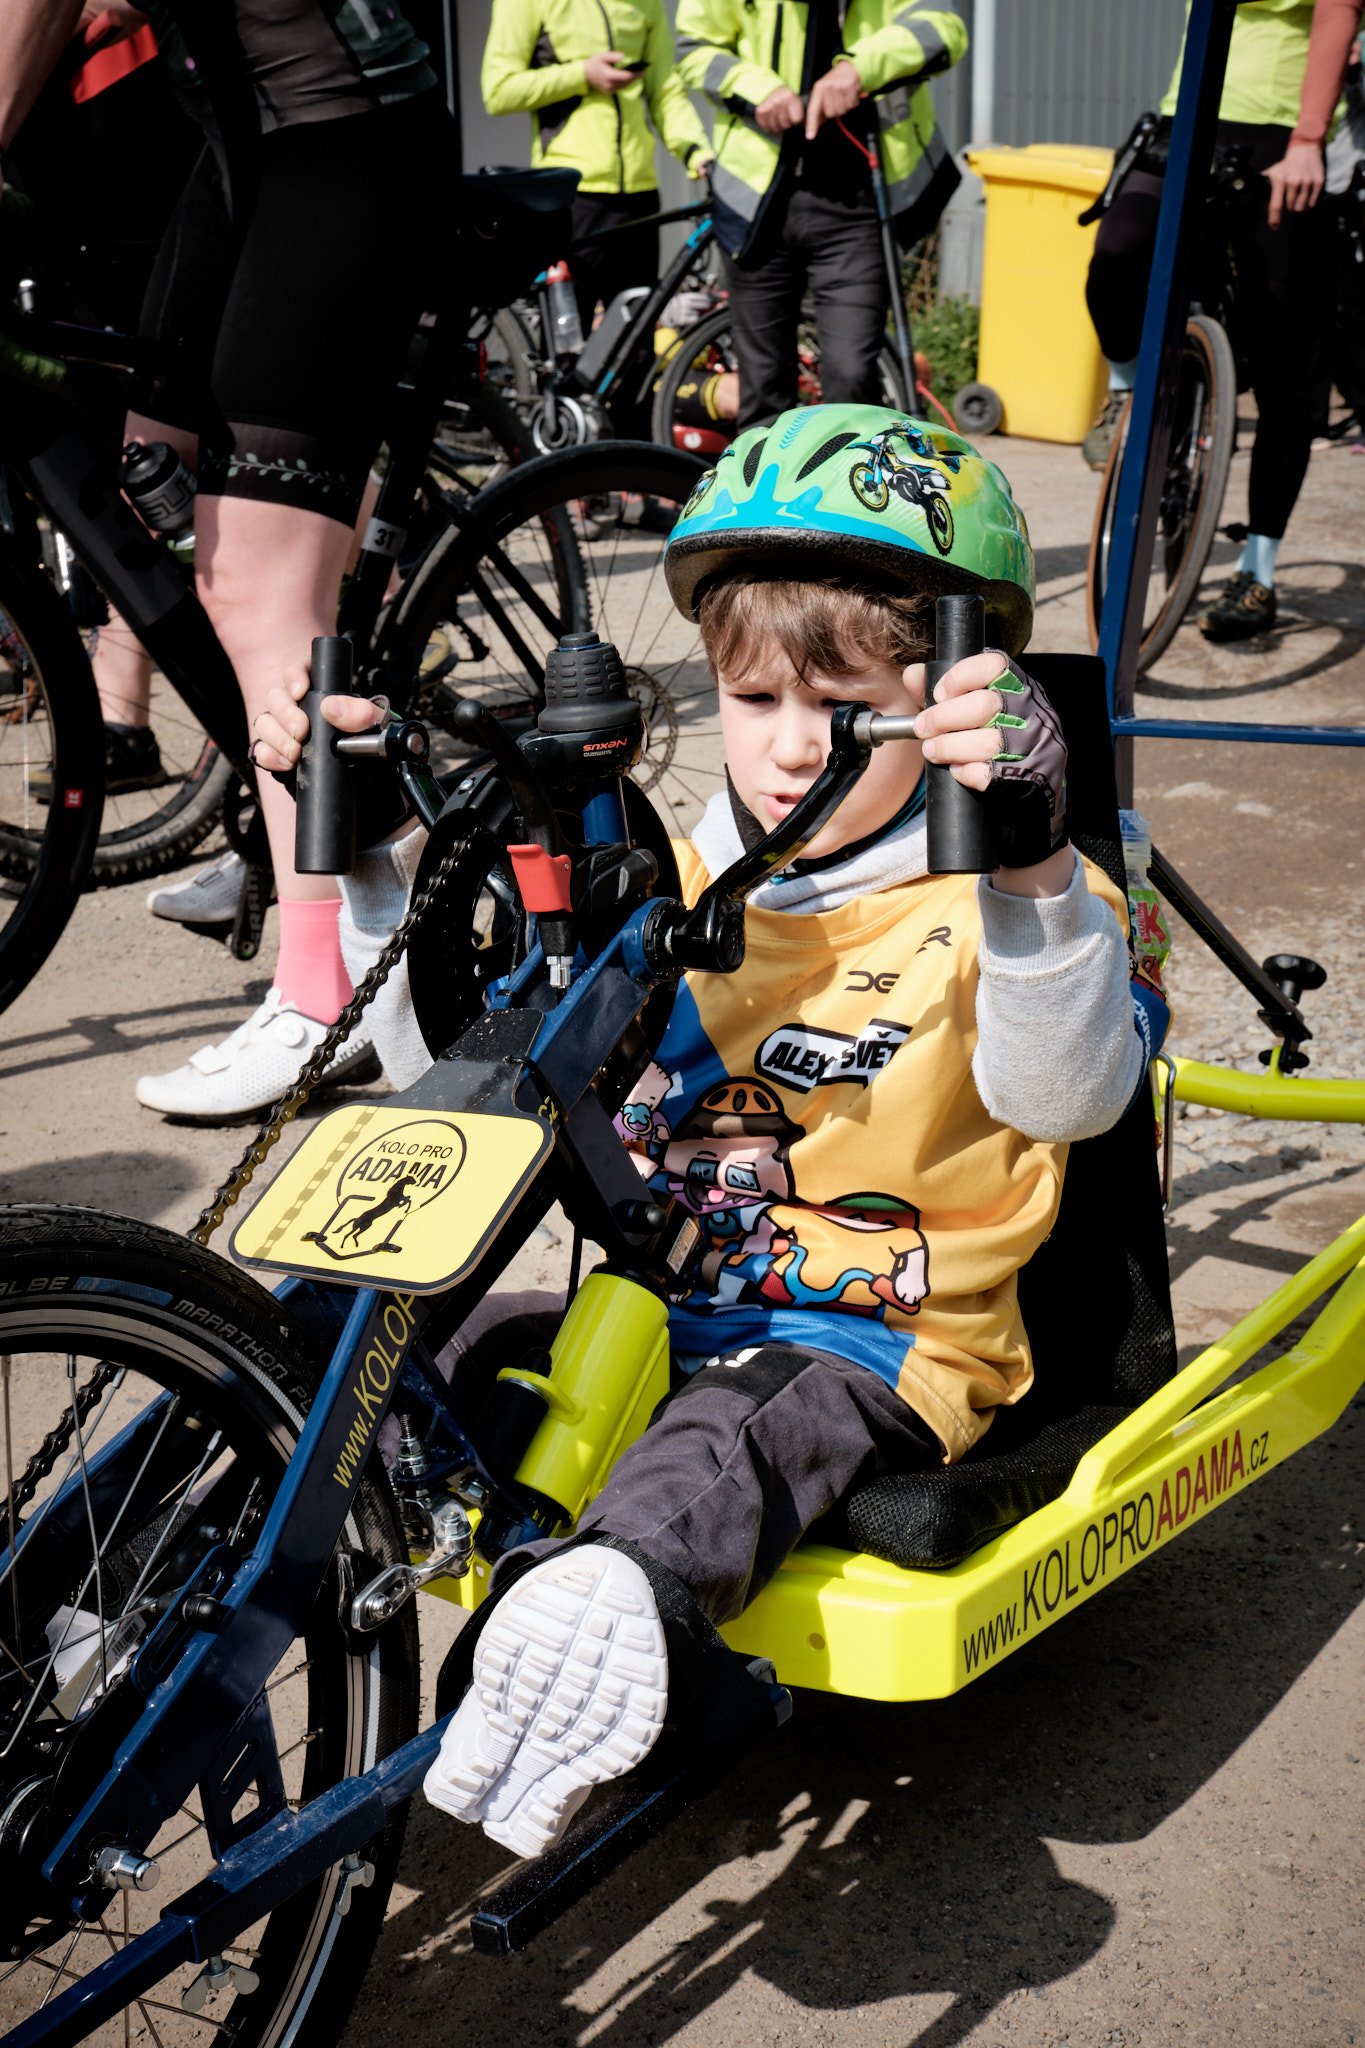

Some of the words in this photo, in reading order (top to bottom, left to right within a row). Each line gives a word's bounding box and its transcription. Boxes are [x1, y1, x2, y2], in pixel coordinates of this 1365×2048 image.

[377, 1140, 419, 1156] KOLO
[419, 1144, 453, 1159] PRO
[348, 1156, 448, 1189] ADAMA
